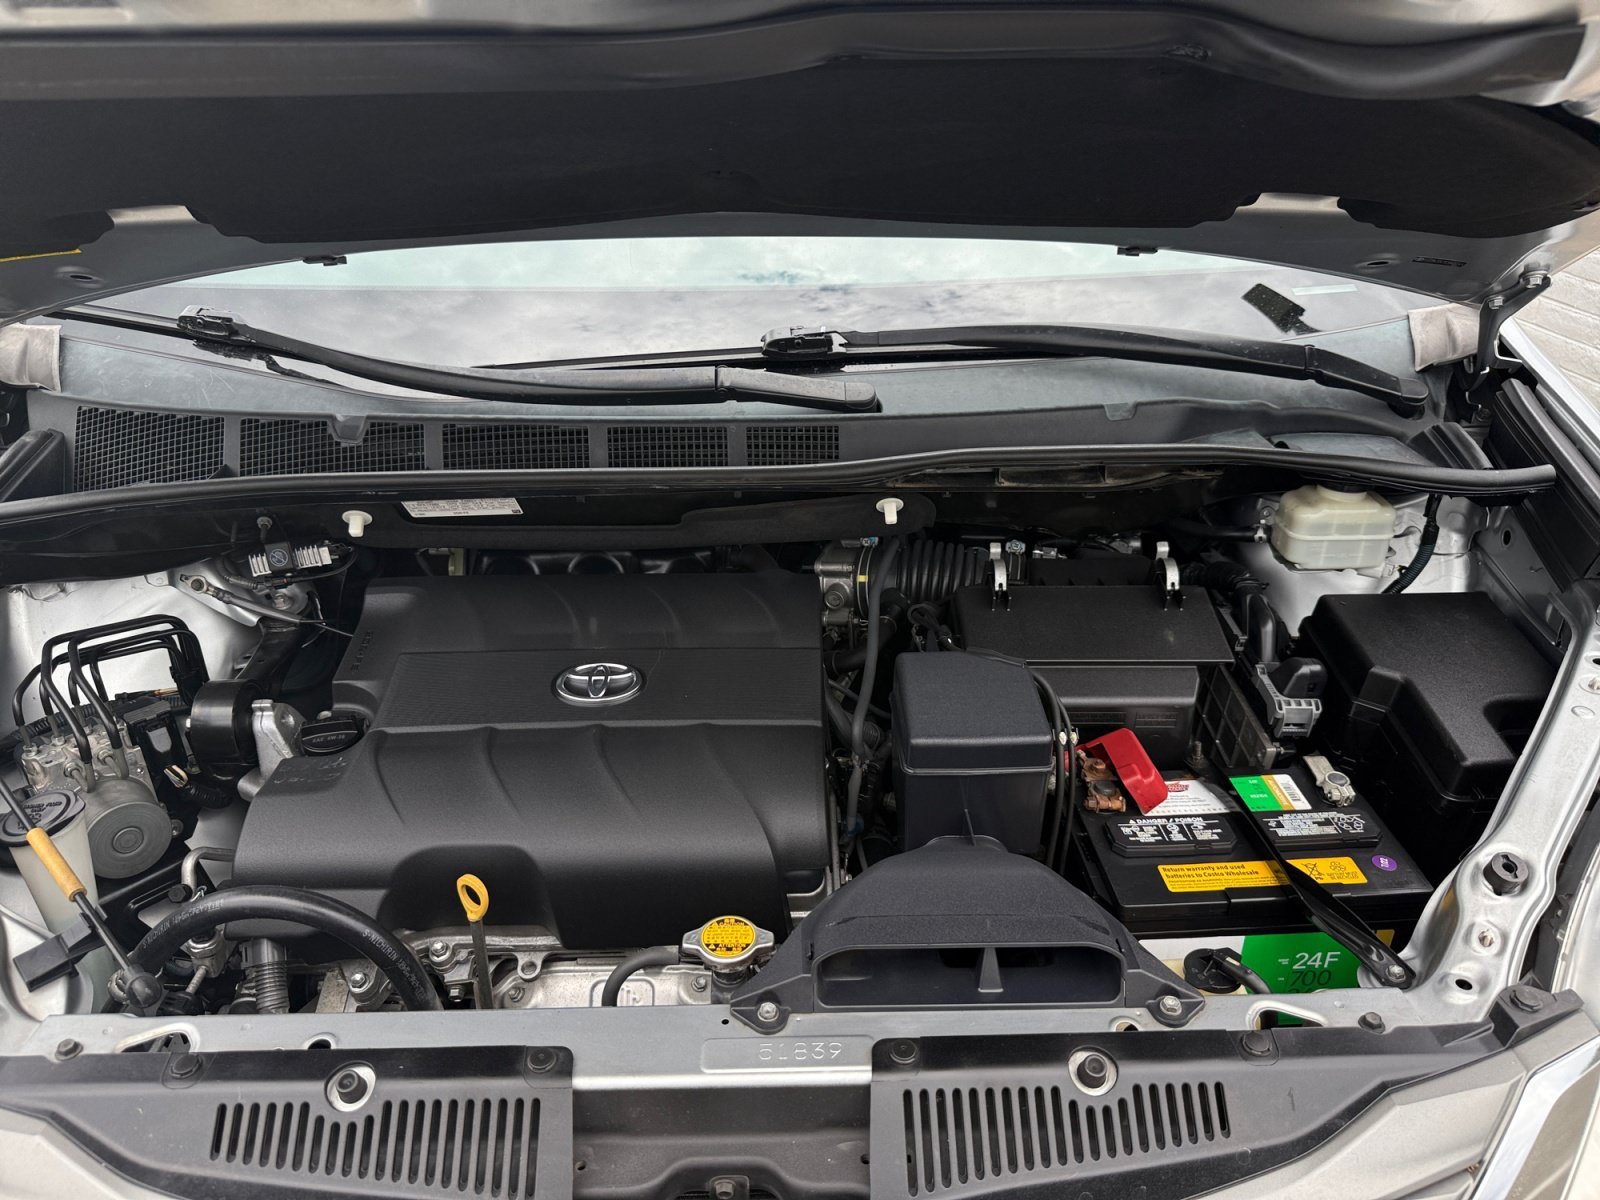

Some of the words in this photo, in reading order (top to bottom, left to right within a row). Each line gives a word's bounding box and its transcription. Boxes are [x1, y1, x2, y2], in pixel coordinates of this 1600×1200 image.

[1226, 869, 1260, 877] Wholesale
[1292, 951, 1341, 970] 24F
[1289, 969, 1332, 987] 700
[758, 1042, 843, 1060] 51839
